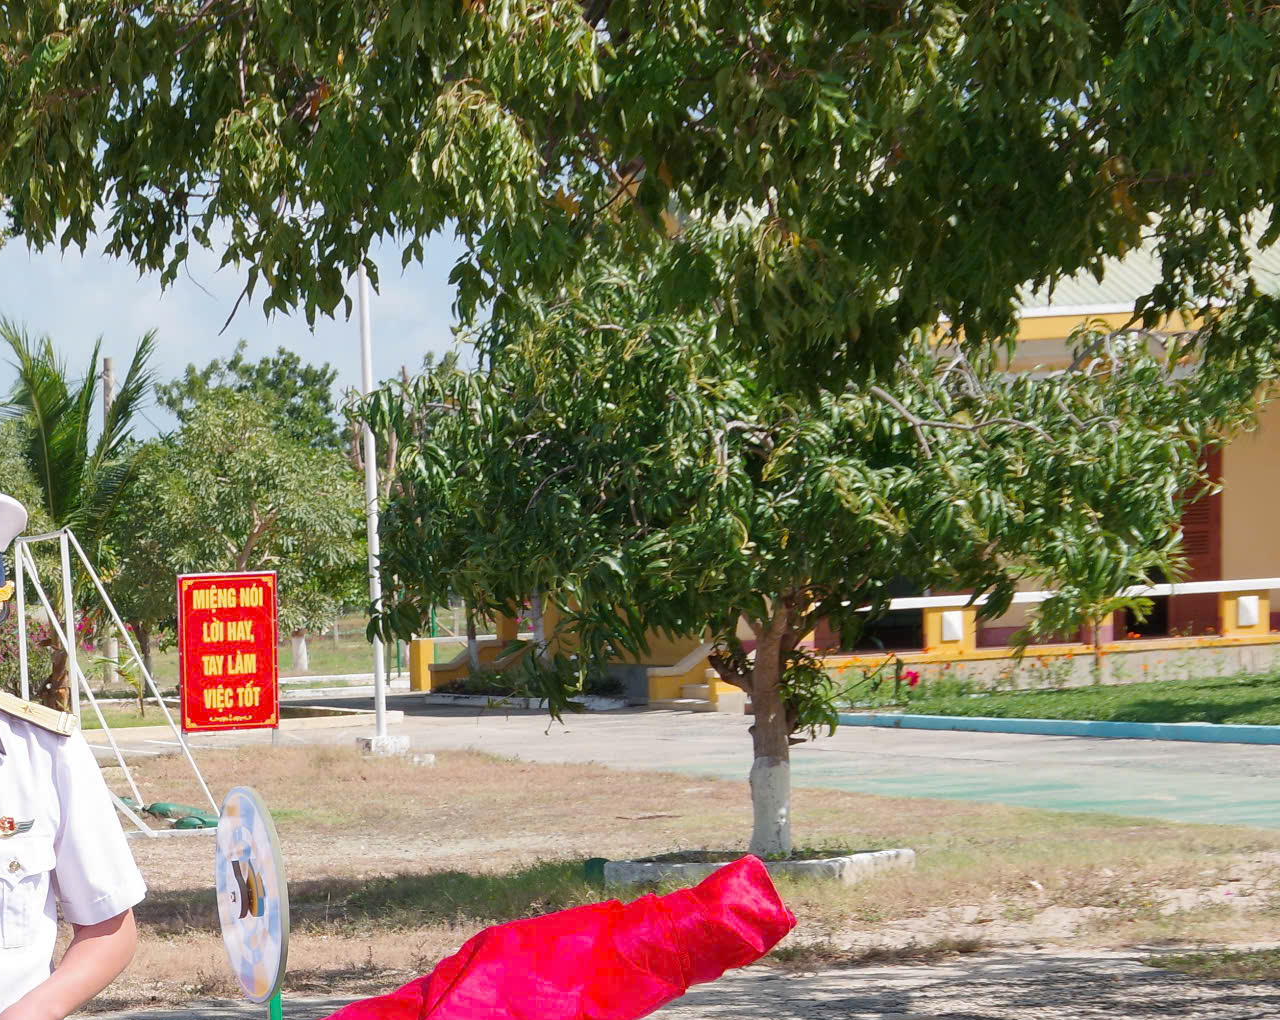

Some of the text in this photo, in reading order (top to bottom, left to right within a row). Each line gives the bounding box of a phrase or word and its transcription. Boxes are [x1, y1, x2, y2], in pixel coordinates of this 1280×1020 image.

[192, 583, 264, 613] MIỆNG NÓI
[202, 616, 255, 643] LỜI HAY,
[202, 650, 257, 676] TAY LÀM
[203, 680, 261, 713] VIỆC TỐT
